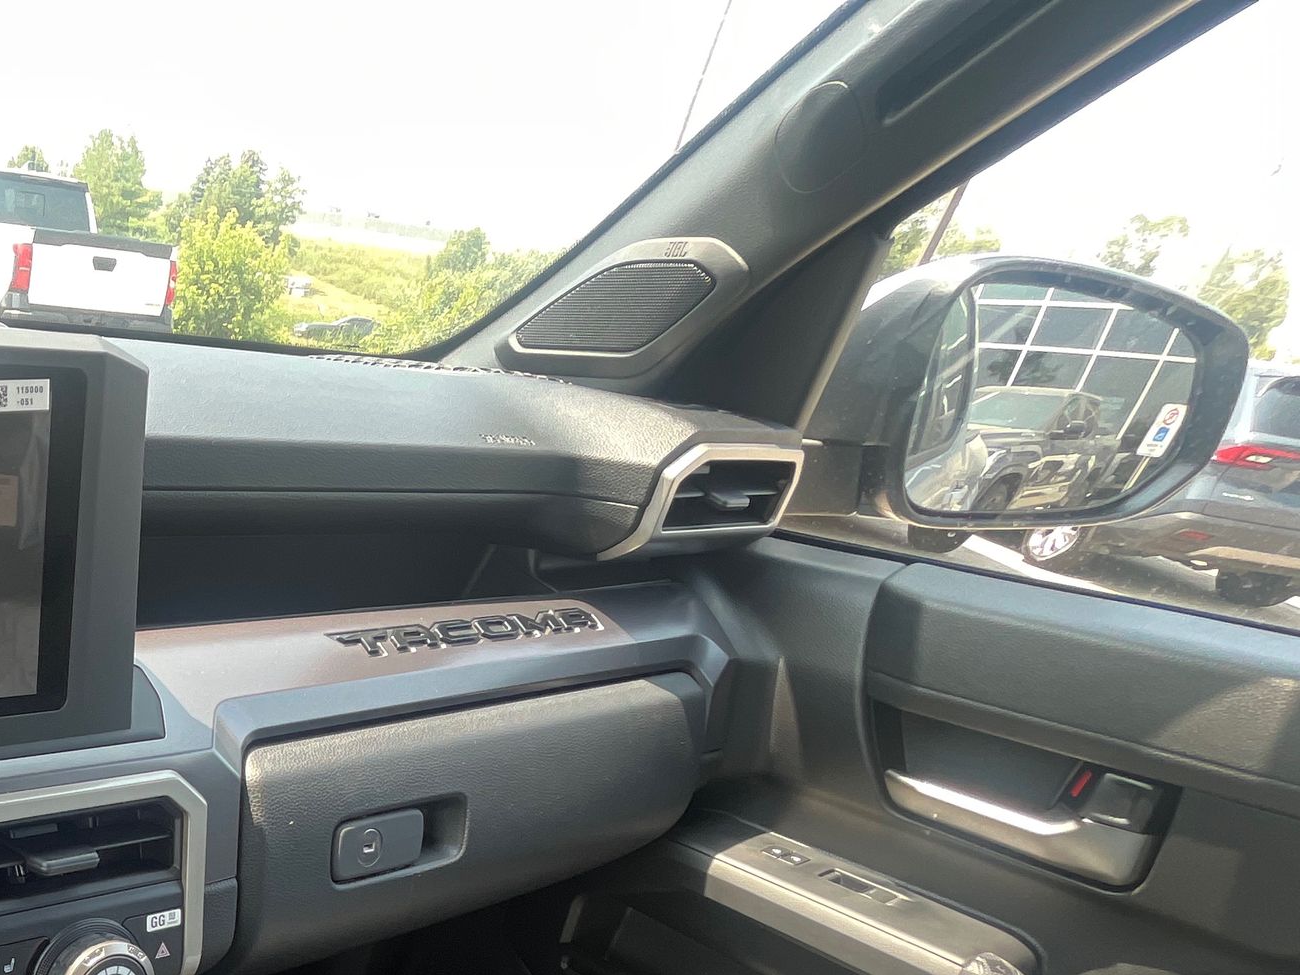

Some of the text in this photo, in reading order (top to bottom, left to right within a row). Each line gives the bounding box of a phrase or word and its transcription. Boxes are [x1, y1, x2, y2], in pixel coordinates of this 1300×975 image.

[16, 385, 44, 394] 115000
[323, 606, 605, 659] TACOMA
[150, 913, 166, 929] GG
